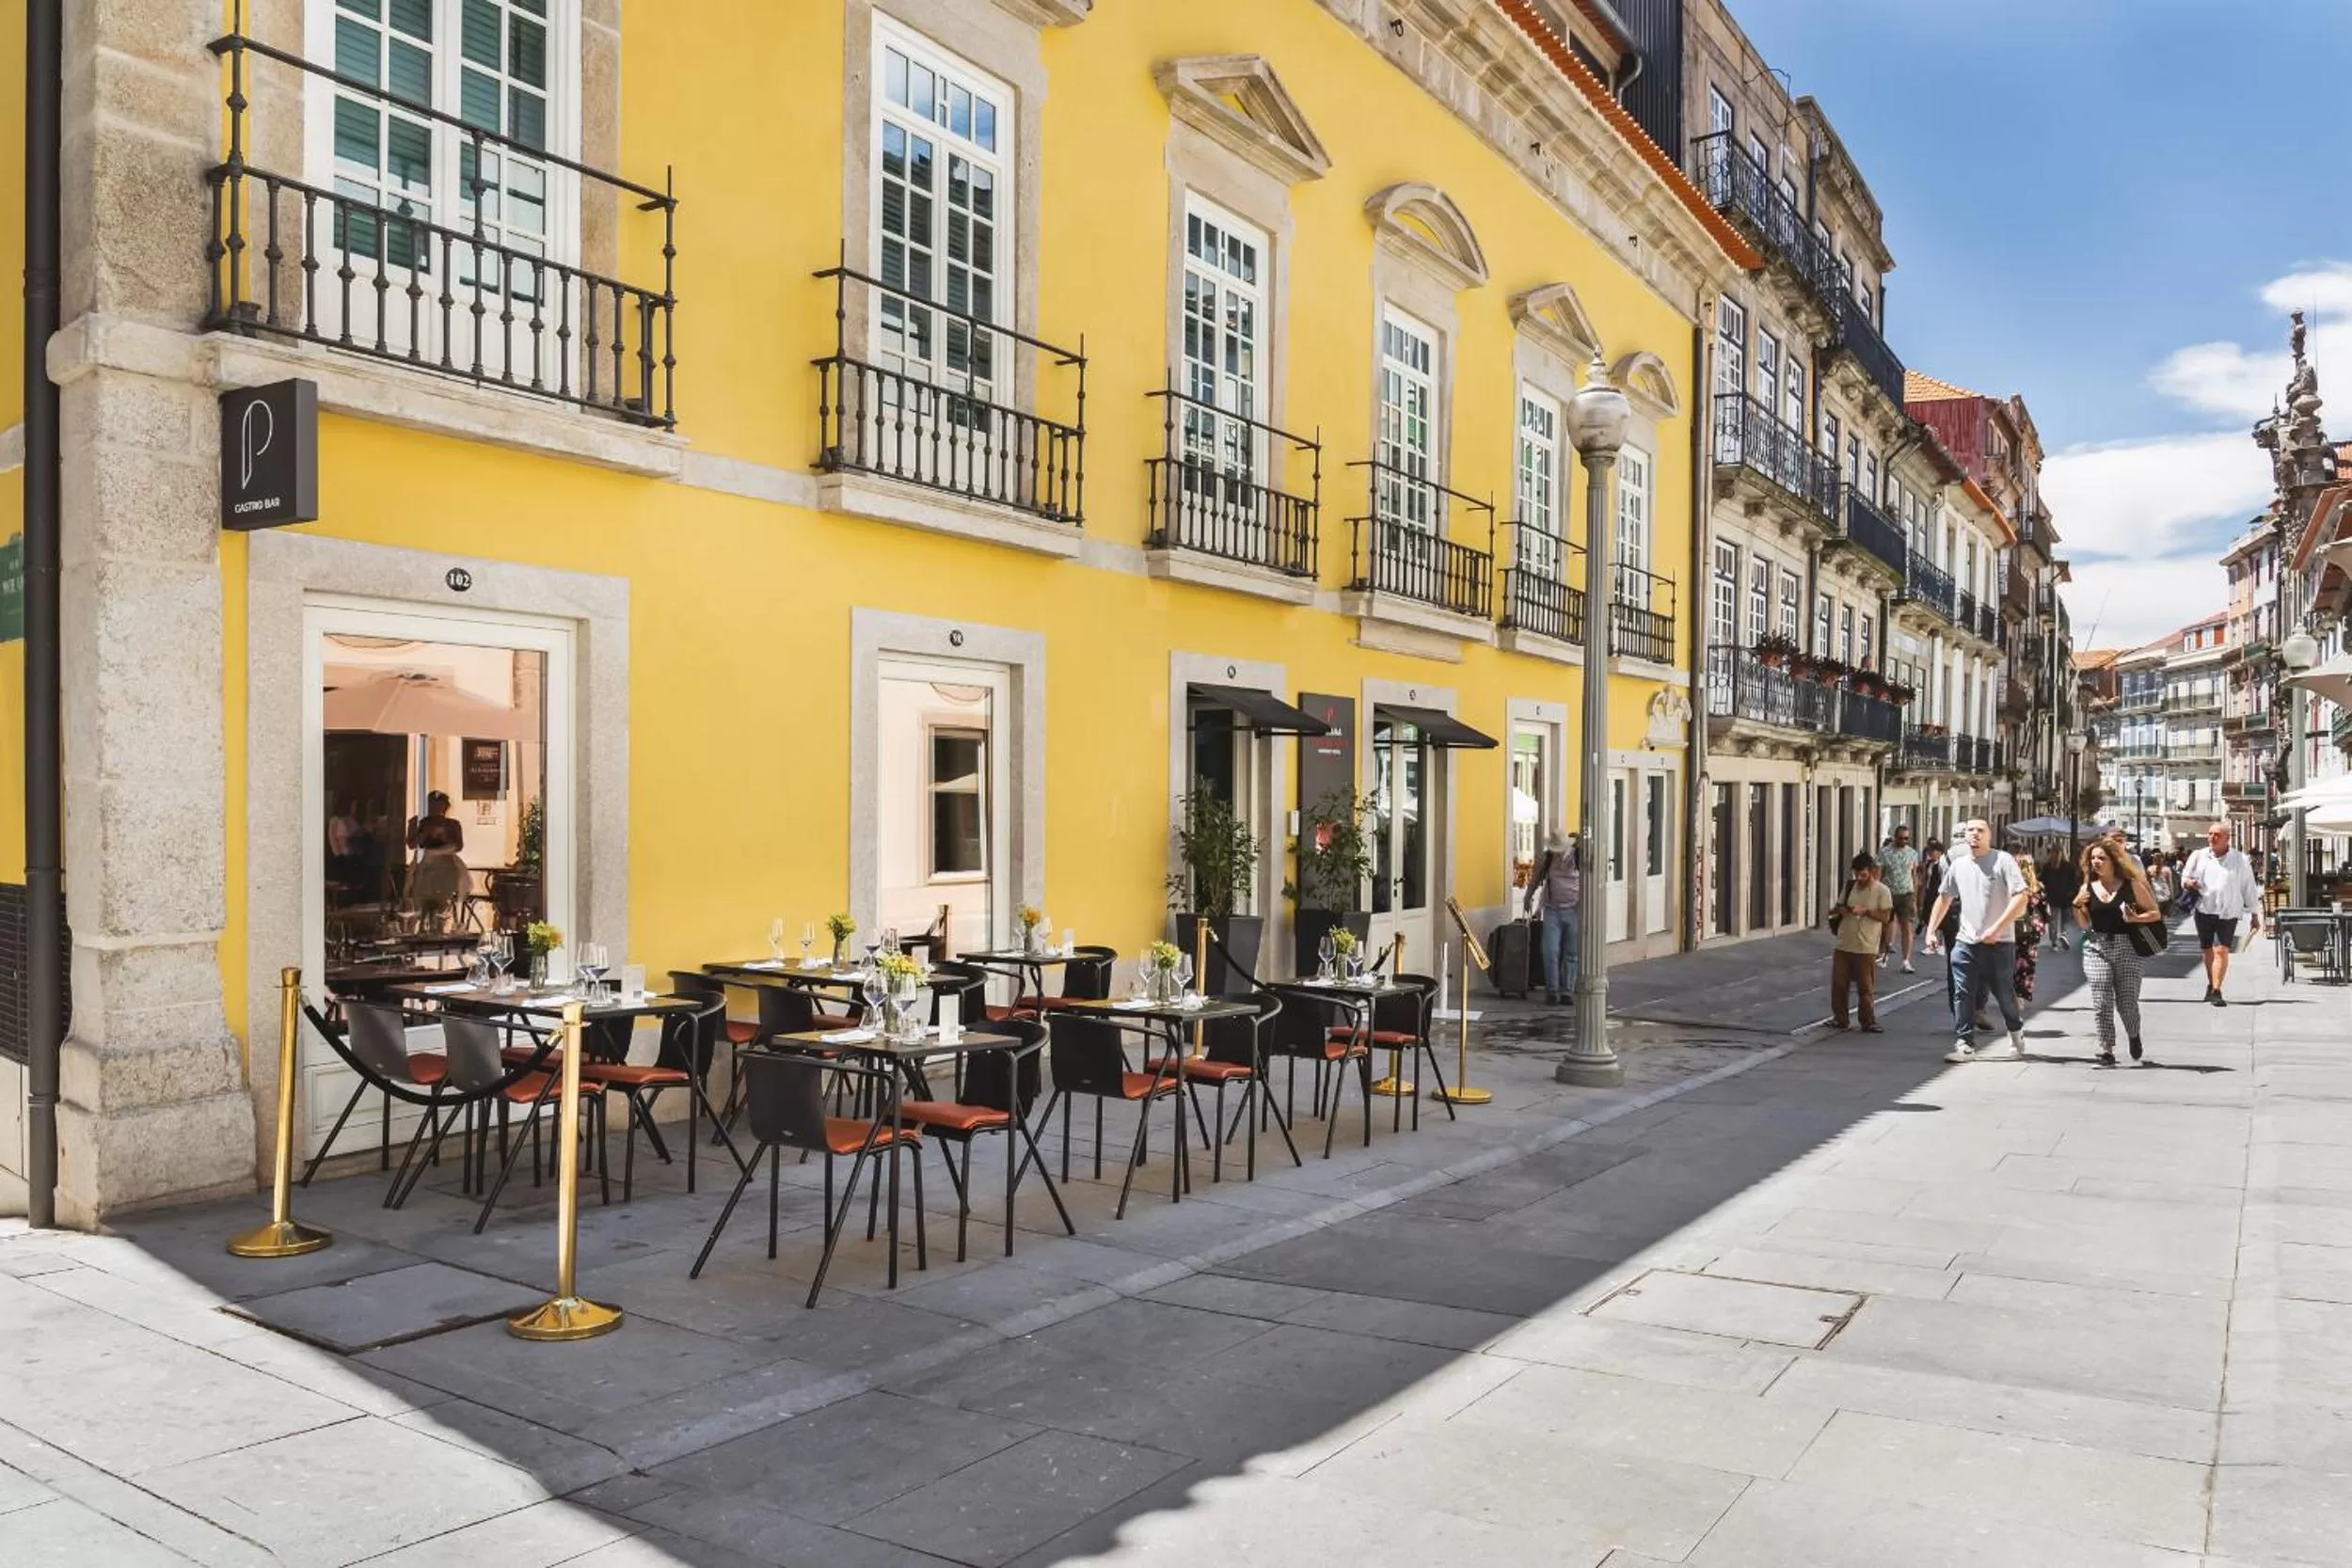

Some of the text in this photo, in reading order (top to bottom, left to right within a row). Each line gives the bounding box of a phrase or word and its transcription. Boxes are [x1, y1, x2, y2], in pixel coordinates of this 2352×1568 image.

[234, 497, 280, 514] GASTRO BAR
[450, 573, 469, 587] 102
